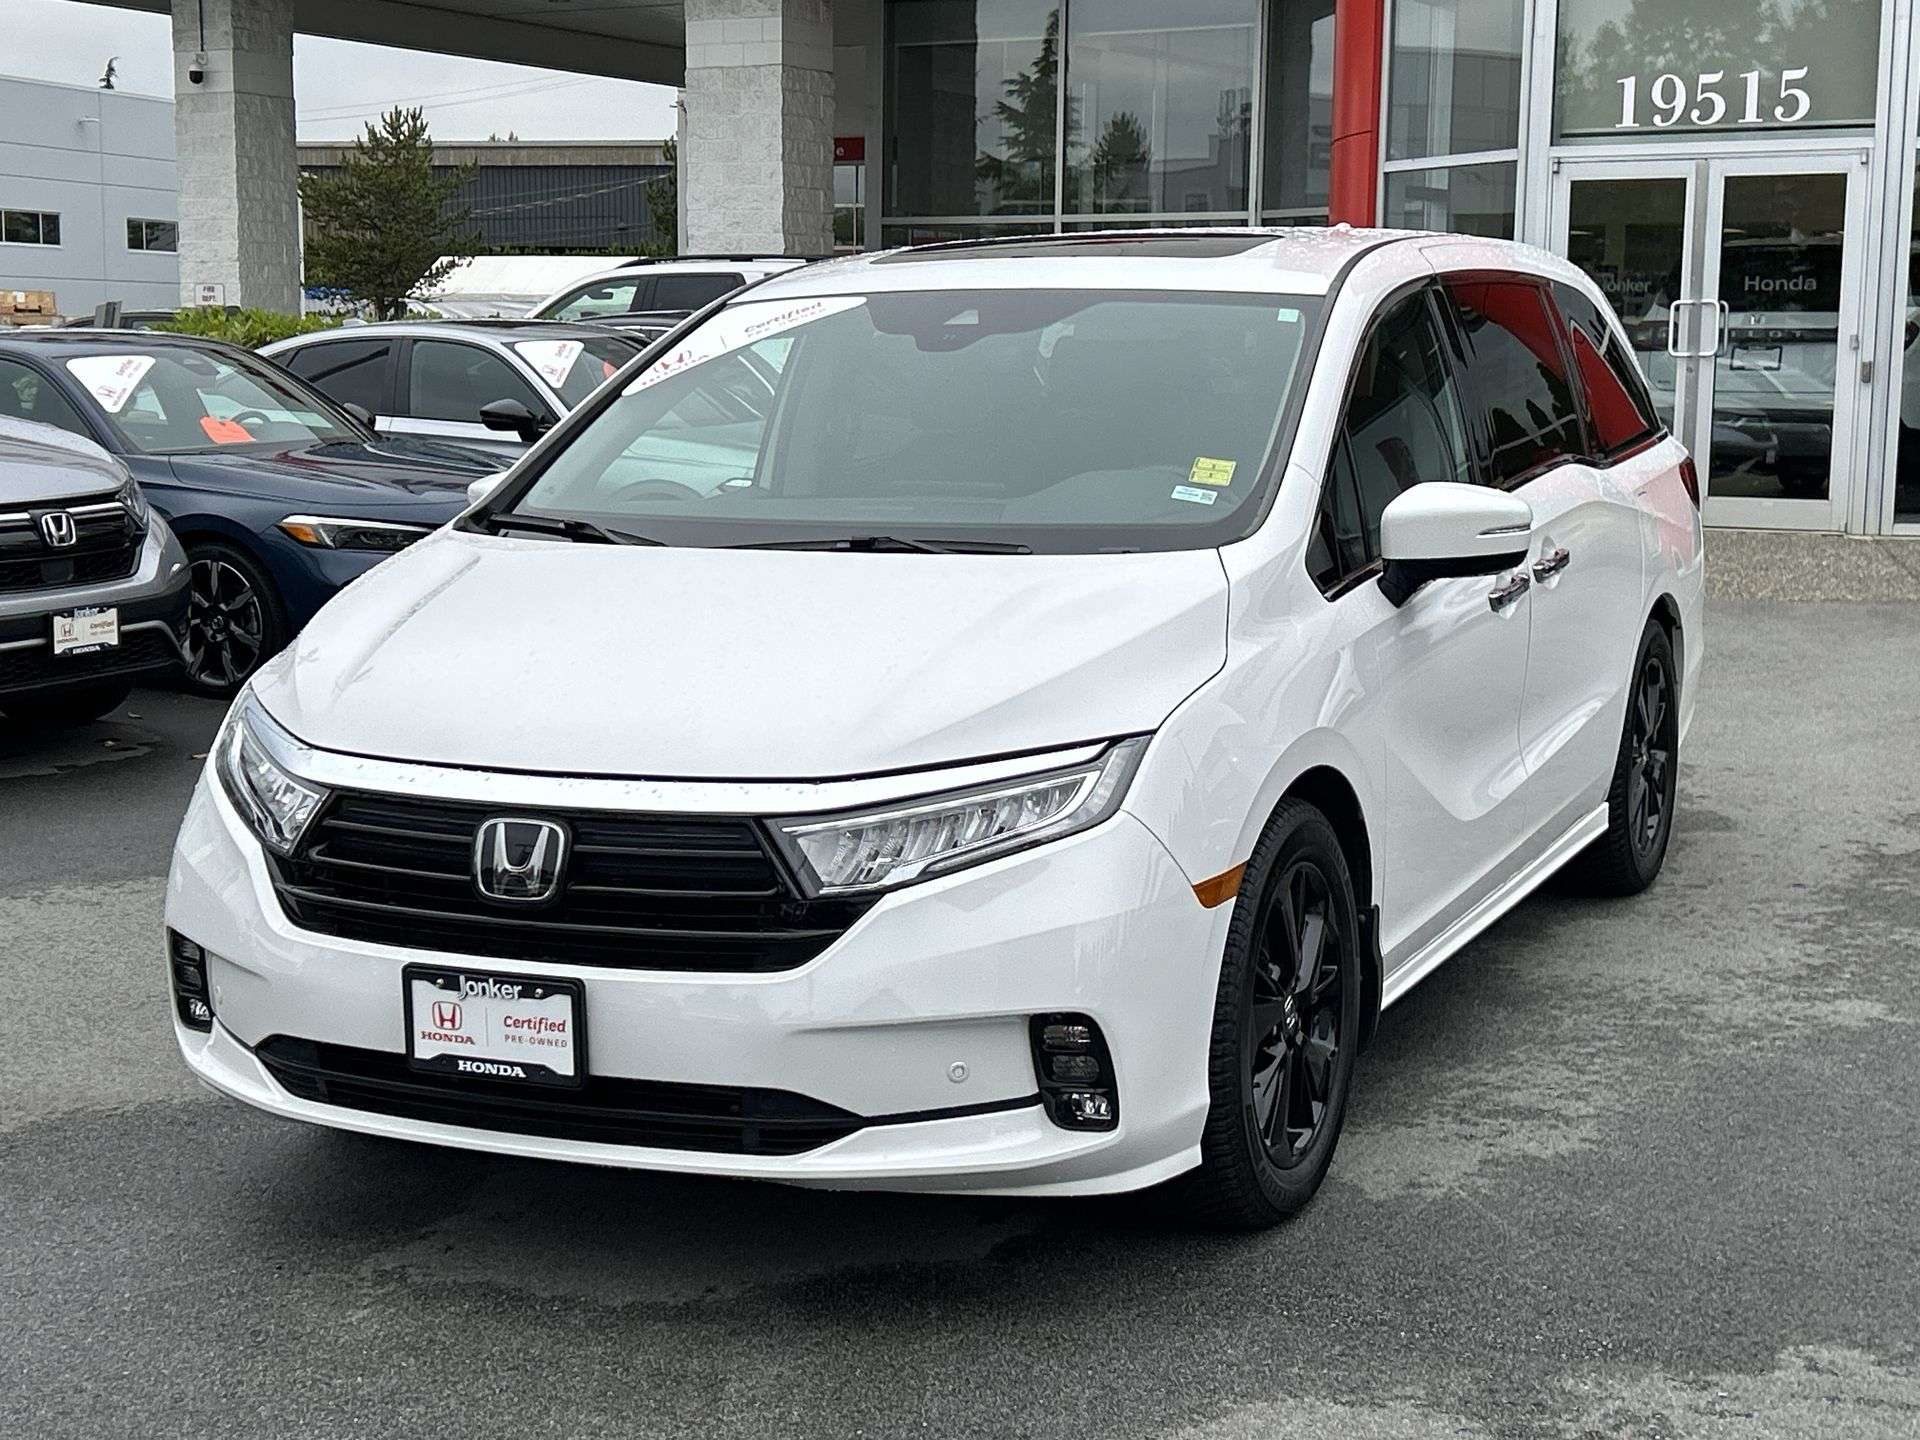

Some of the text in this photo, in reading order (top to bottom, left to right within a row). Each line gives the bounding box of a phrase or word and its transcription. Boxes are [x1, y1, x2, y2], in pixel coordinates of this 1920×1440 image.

[1615, 66, 1811, 128] 19515
[1744, 276, 1817, 291] Honda
[457, 975, 522, 1000] Jonker
[504, 1015, 566, 1034] Certified
[421, 1030, 475, 1045] HONDA
[504, 1034, 568, 1048] PRE-OWNED
[458, 1060, 526, 1078] HONDA
